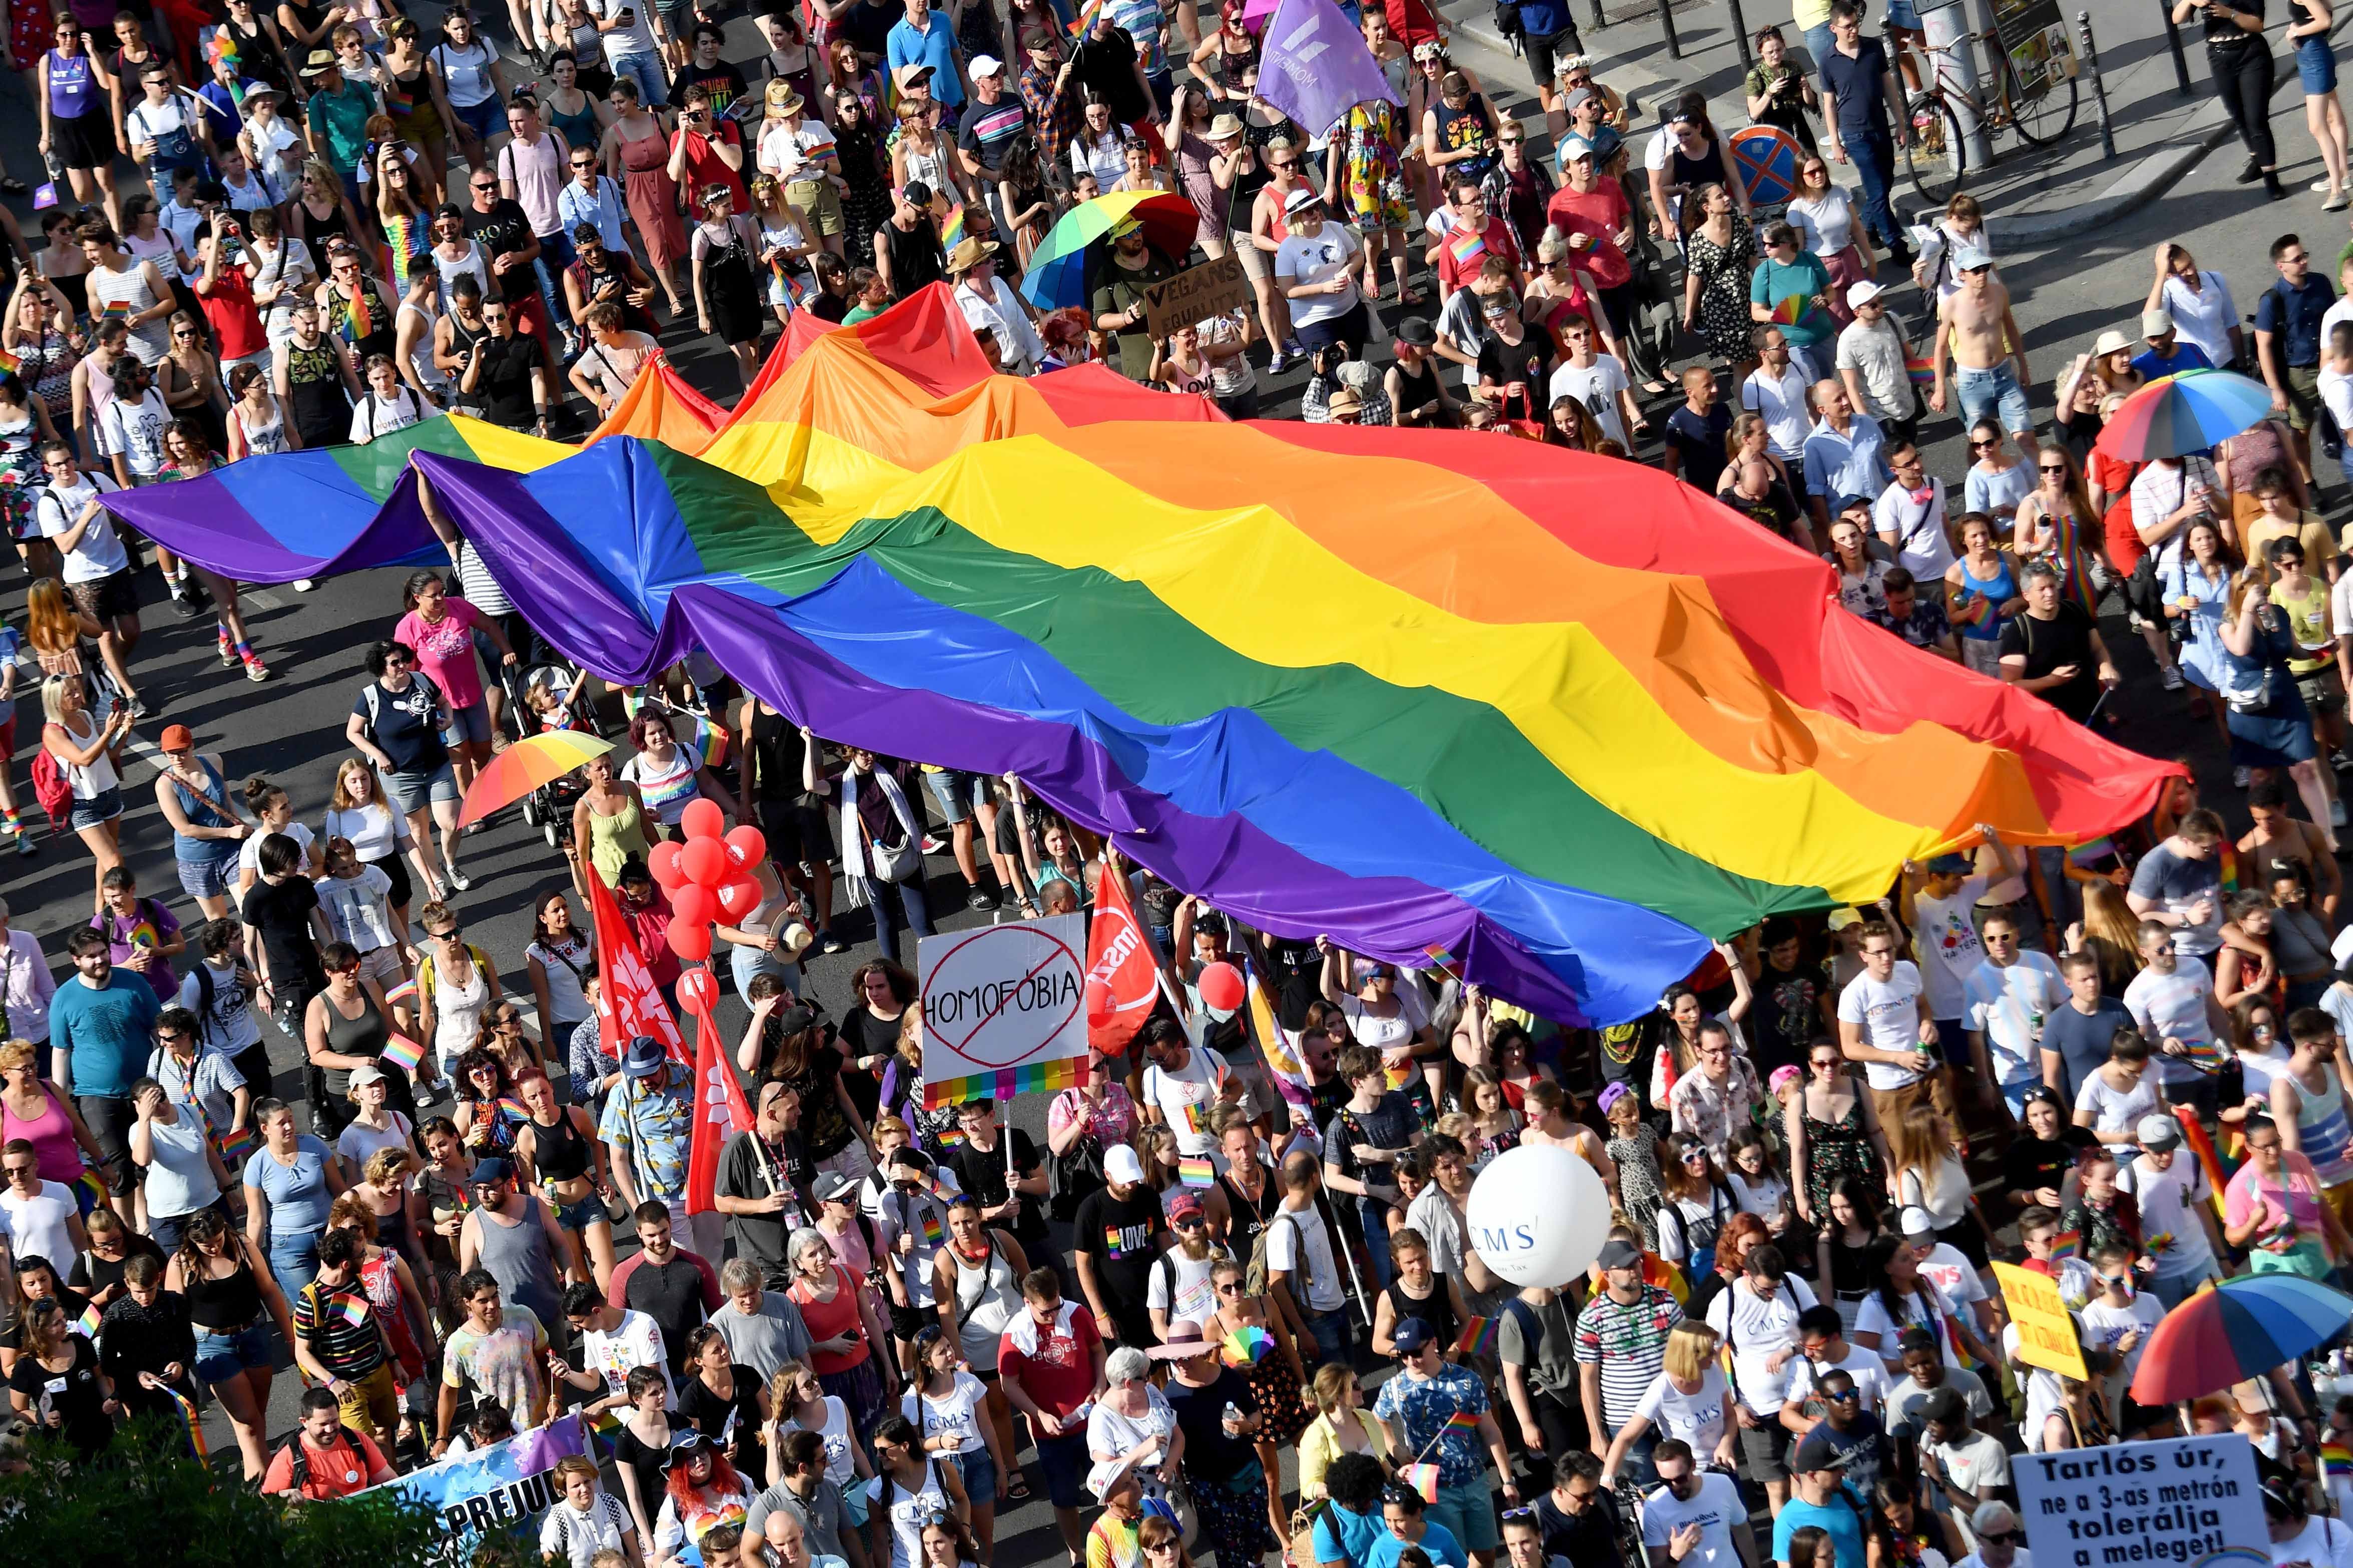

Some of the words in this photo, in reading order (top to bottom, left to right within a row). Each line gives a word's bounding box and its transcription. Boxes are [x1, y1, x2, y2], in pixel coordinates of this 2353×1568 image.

[473, 219, 519, 243] BOS
[1146, 260, 1240, 308] VEGANS
[1161, 288, 1239, 331] EQUALITY
[1180, 373, 1216, 394] LOVE
[924, 969, 1079, 1028] HOMOFÓBIA
[918, 1205, 938, 1224] LOVE
[1118, 1223, 1146, 1252] LOVE
[1470, 1224, 1534, 1252] CMS
[1747, 1314, 1788, 1336] CMS
[928, 1409, 970, 1430] CMS
[1683, 1404, 1720, 1429] CMS
[2038, 1449, 2157, 1481] Tarlós
[2174, 1444, 2224, 1469] úr,
[2040, 1496, 2067, 1514] ne
[2076, 1494, 2090, 1511] a
[2098, 1485, 2149, 1509] 3-as
[2158, 1474, 2239, 1503] metrón
[1679, 1510, 1718, 1529] BlackRock
[2067, 1504, 2219, 1539] tolerálja
[2074, 1549, 2090, 1566] a
[2102, 1530, 2224, 1562] meleget!
